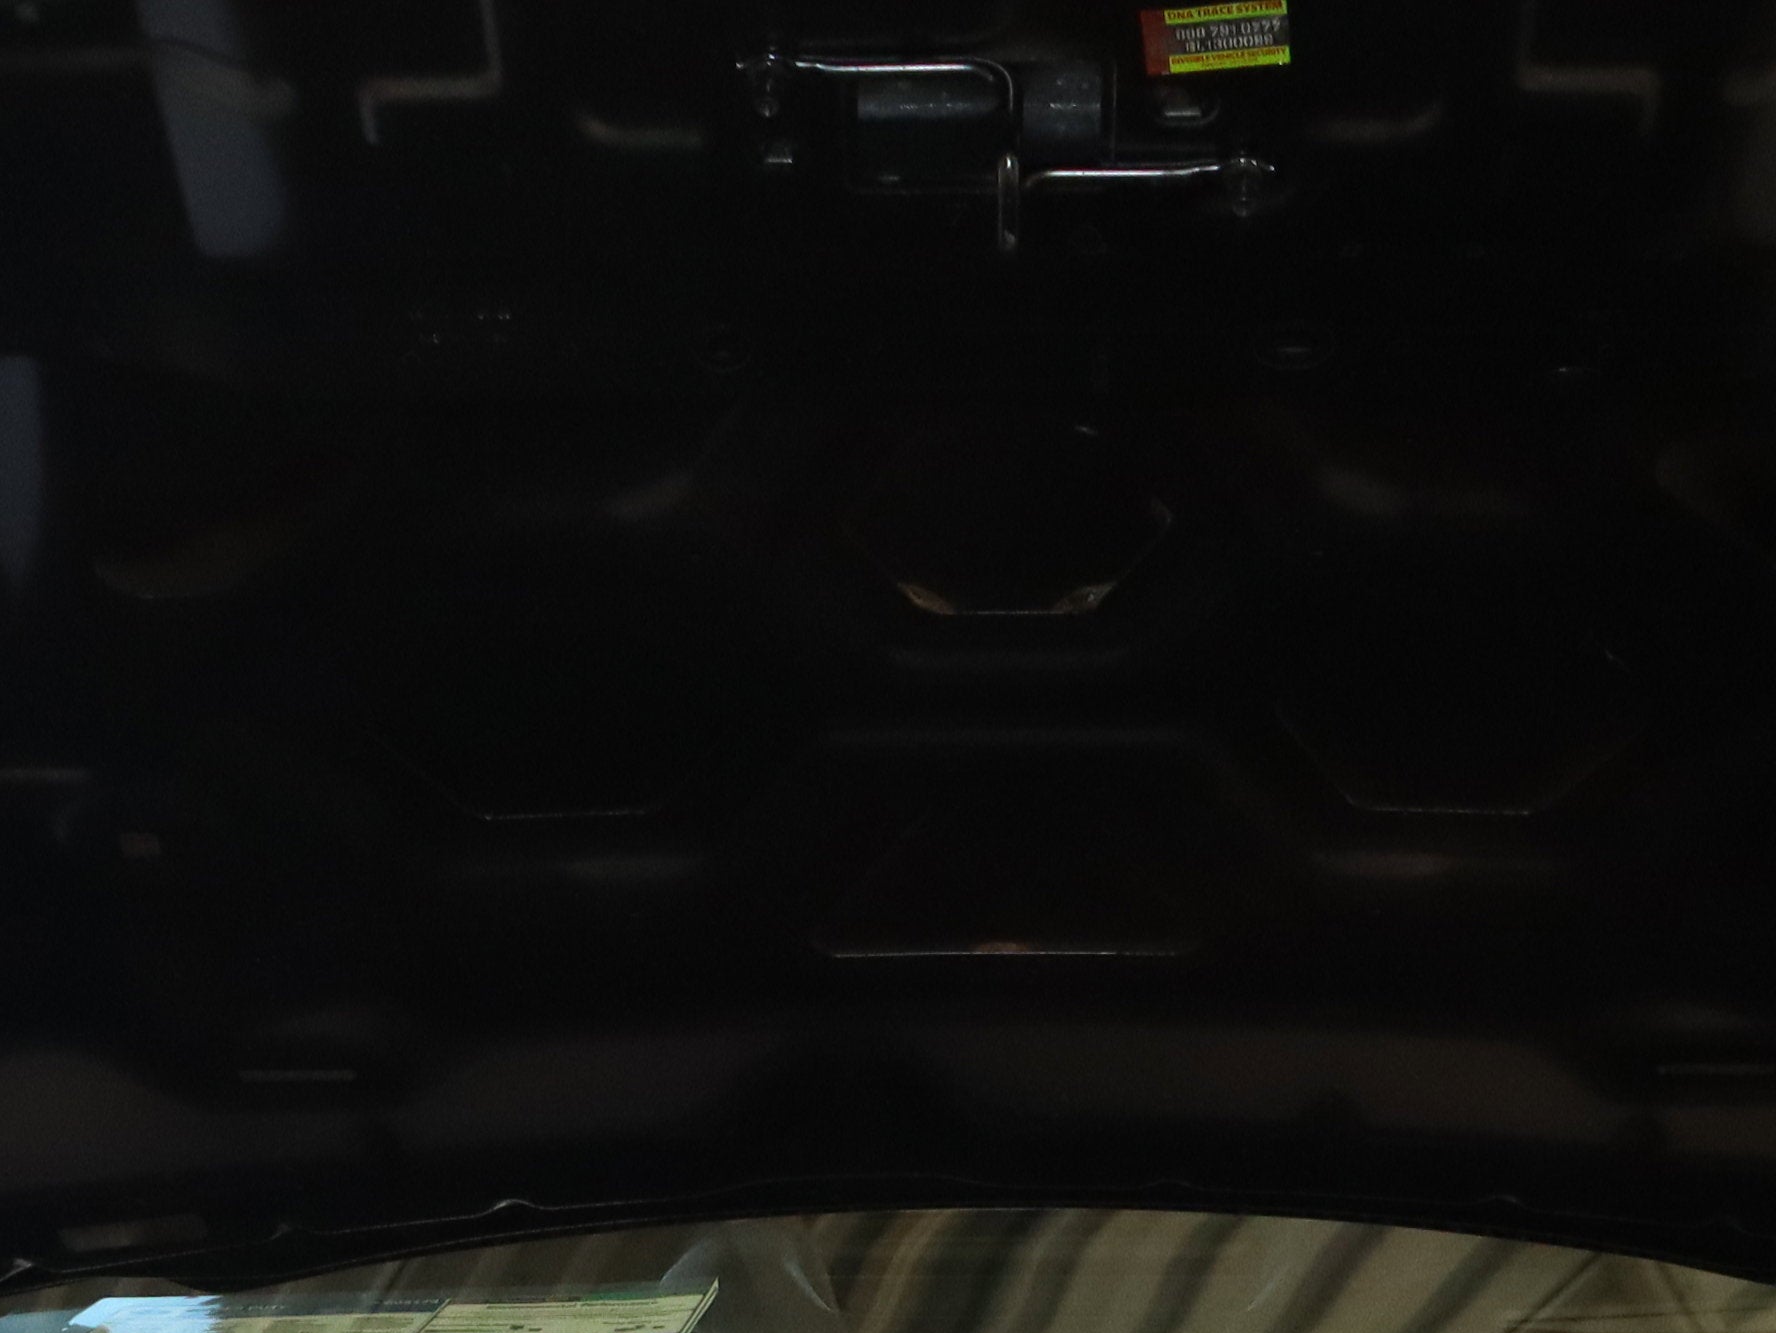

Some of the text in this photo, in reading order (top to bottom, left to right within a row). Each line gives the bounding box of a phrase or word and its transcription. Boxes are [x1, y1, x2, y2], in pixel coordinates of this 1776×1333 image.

[1167, 0, 1282, 19] DNA TRACE SYSTEM
